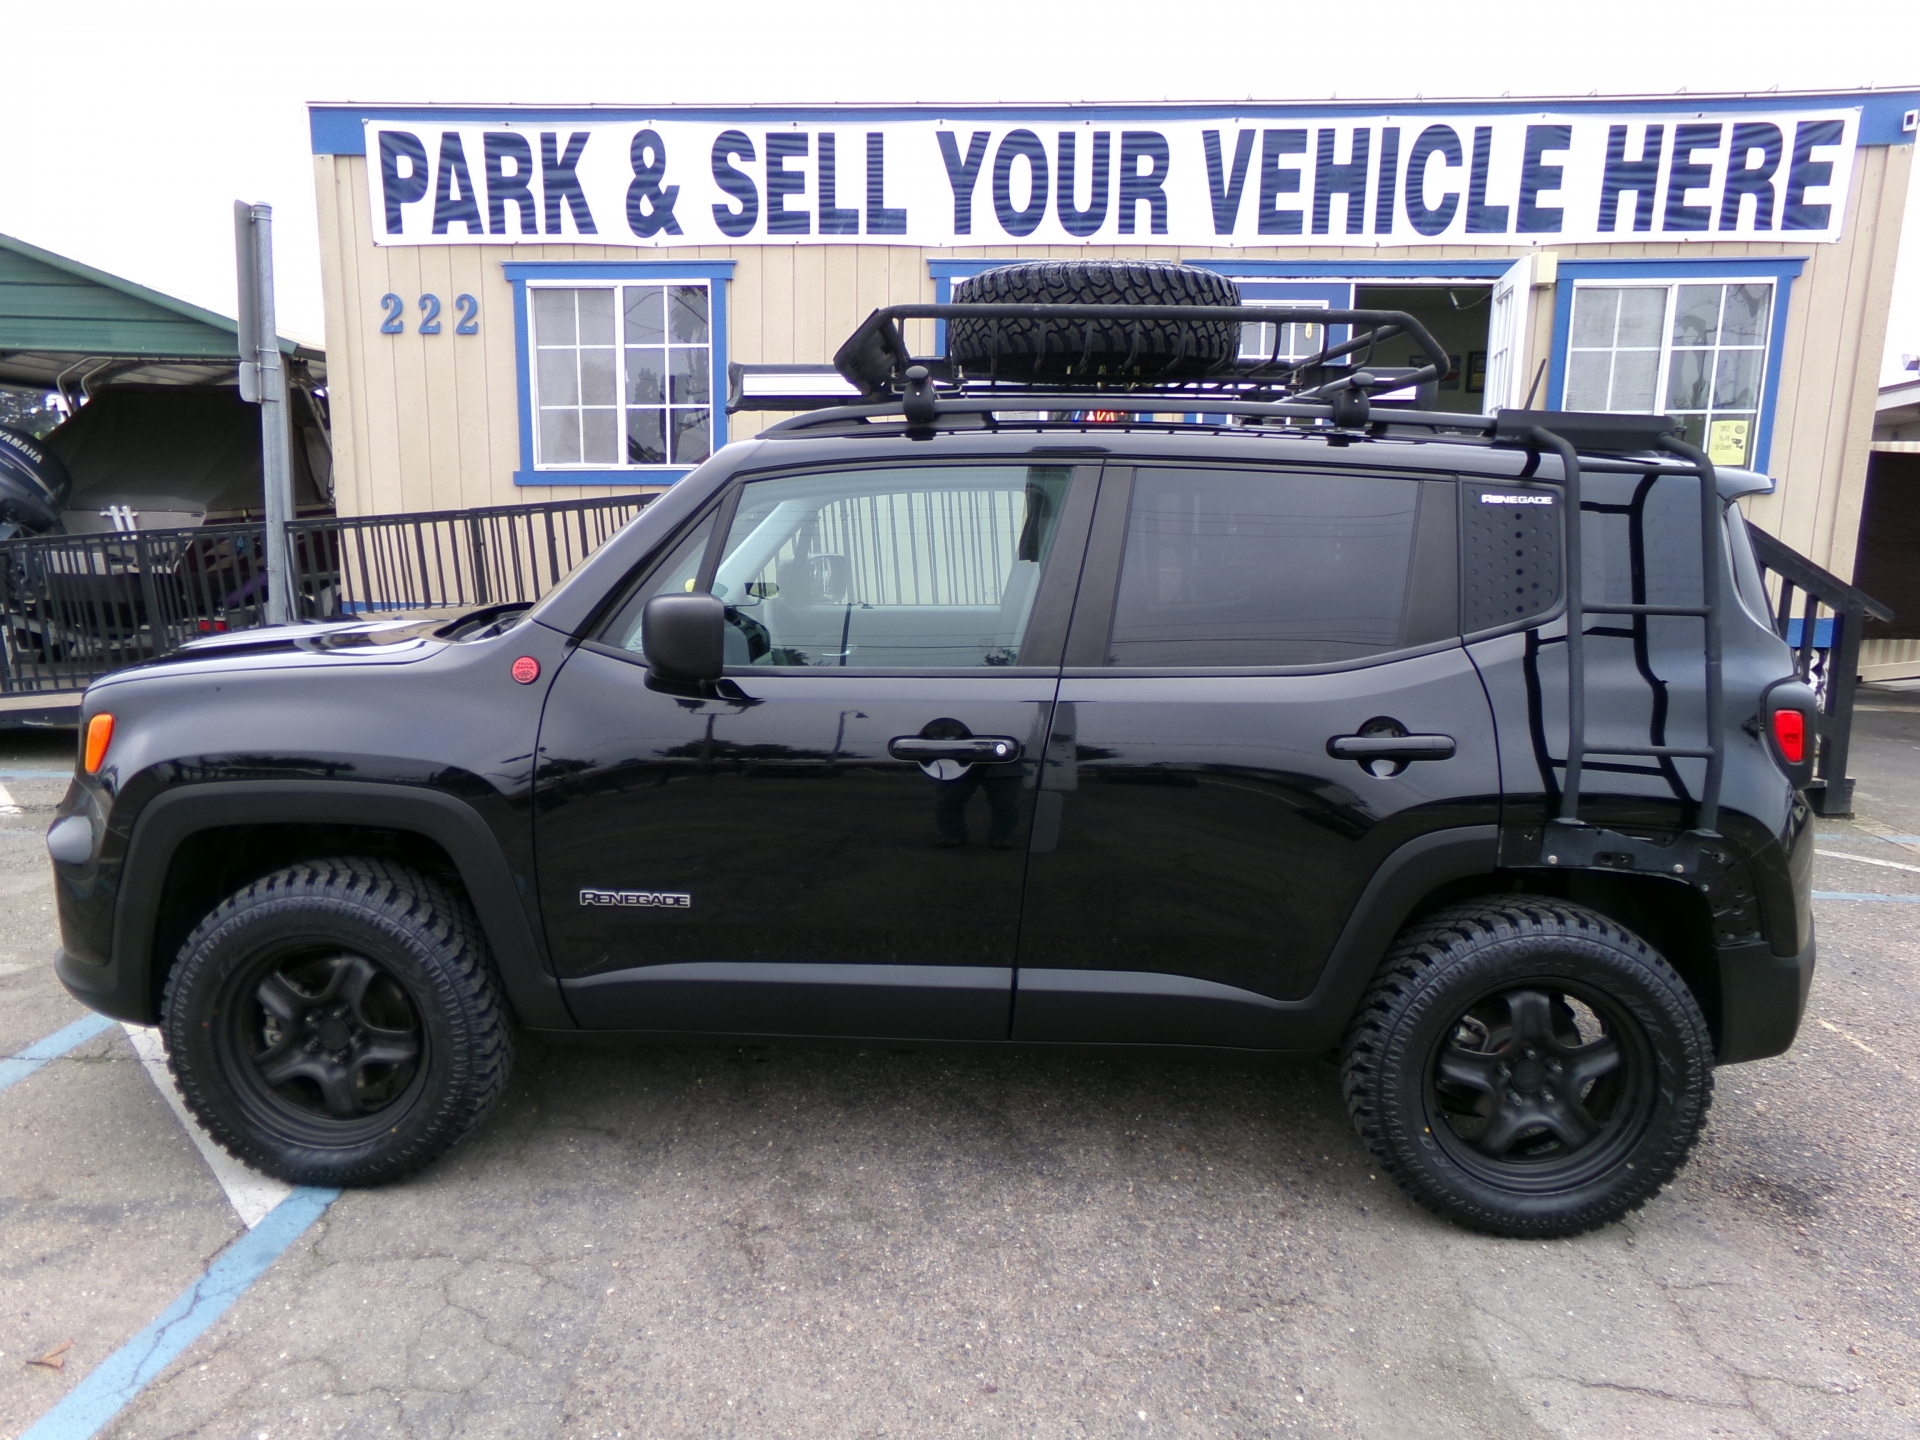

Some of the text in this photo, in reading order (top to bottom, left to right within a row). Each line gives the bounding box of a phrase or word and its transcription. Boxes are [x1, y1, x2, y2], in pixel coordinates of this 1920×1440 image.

[378, 119, 1846, 239] PARK & SELL YOUR VEHICLE HERE
[380, 292, 480, 335] 222
[1481, 493, 1553, 505] RENEGADE
[580, 890, 691, 908] RENEGADE
